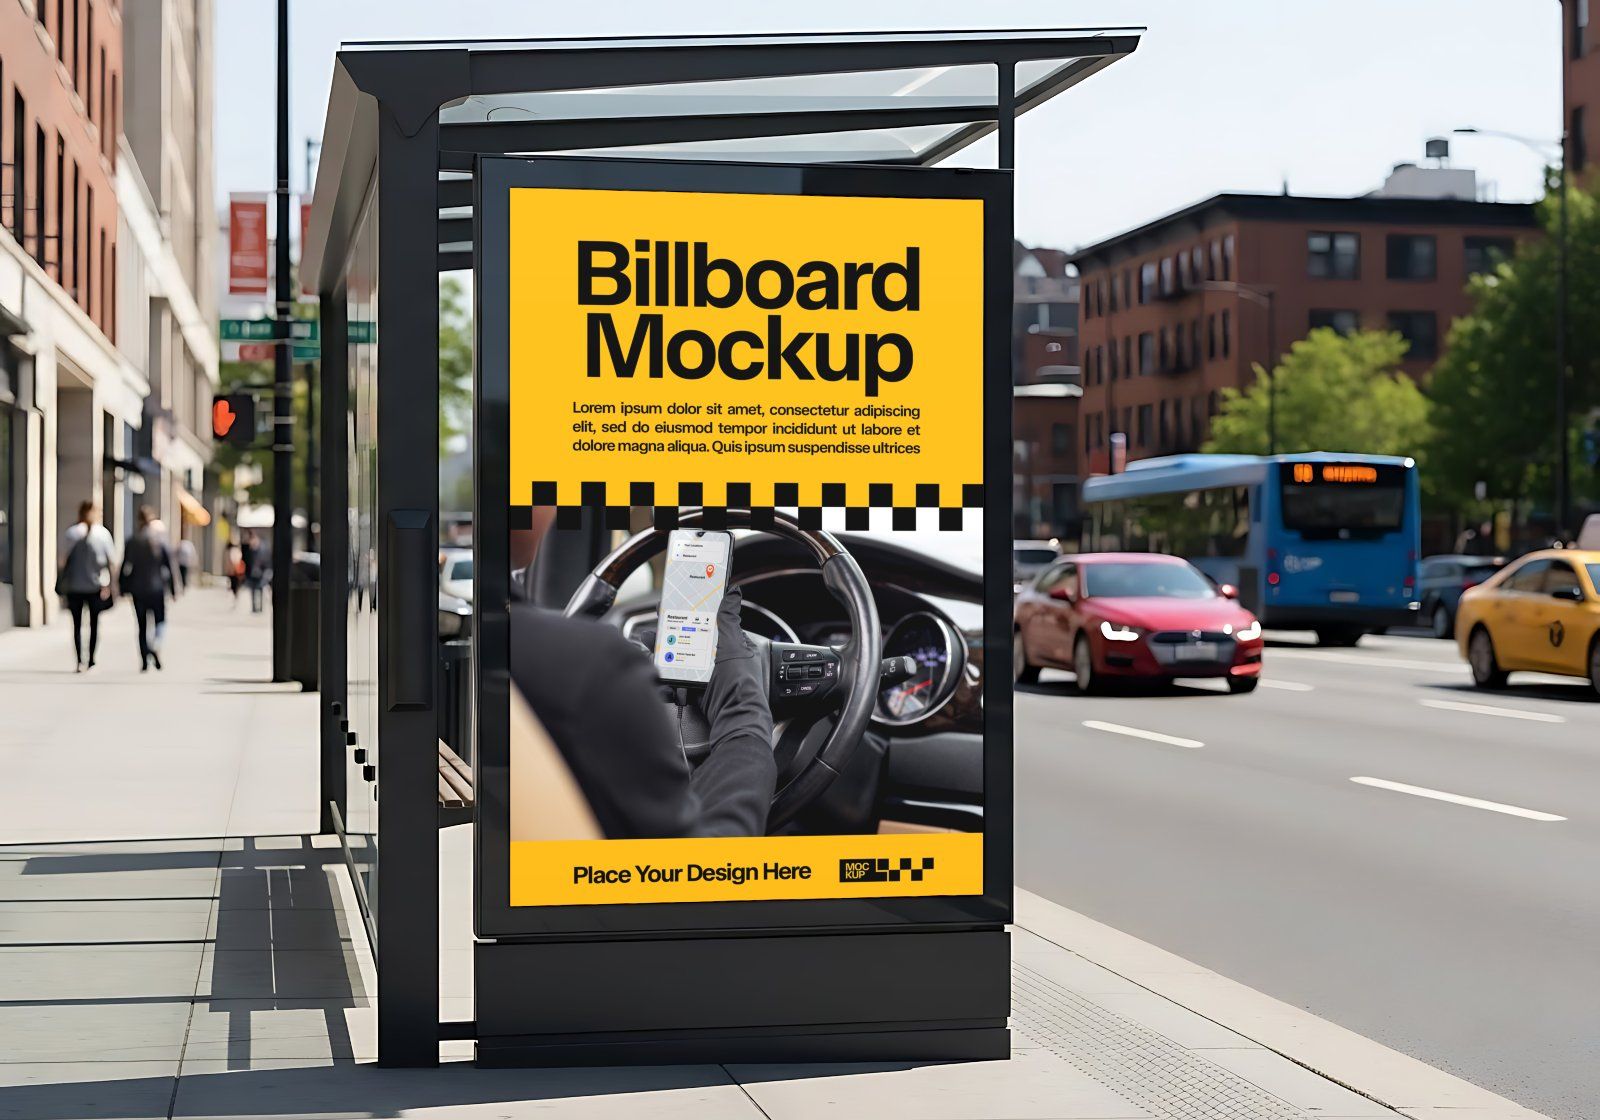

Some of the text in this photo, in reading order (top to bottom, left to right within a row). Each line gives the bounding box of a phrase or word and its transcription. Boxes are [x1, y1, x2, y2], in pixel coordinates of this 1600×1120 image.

[578, 239, 920, 312] Billboard
[587, 312, 914, 397] Mockup
[572, 401, 921, 420] Lorem ipsum dolor sit amet, consectetur adipiscing
[572, 420, 921, 437] elit, sed do eiusmod tempor incididunt ut labore et
[572, 438, 921, 456] dolore magna aliqua. Quis ipsum suspendisse ultrices
[573, 862, 812, 885] Place Your Design Here
[845, 862, 870, 871] MOC
[845, 870, 866, 879] KUP
